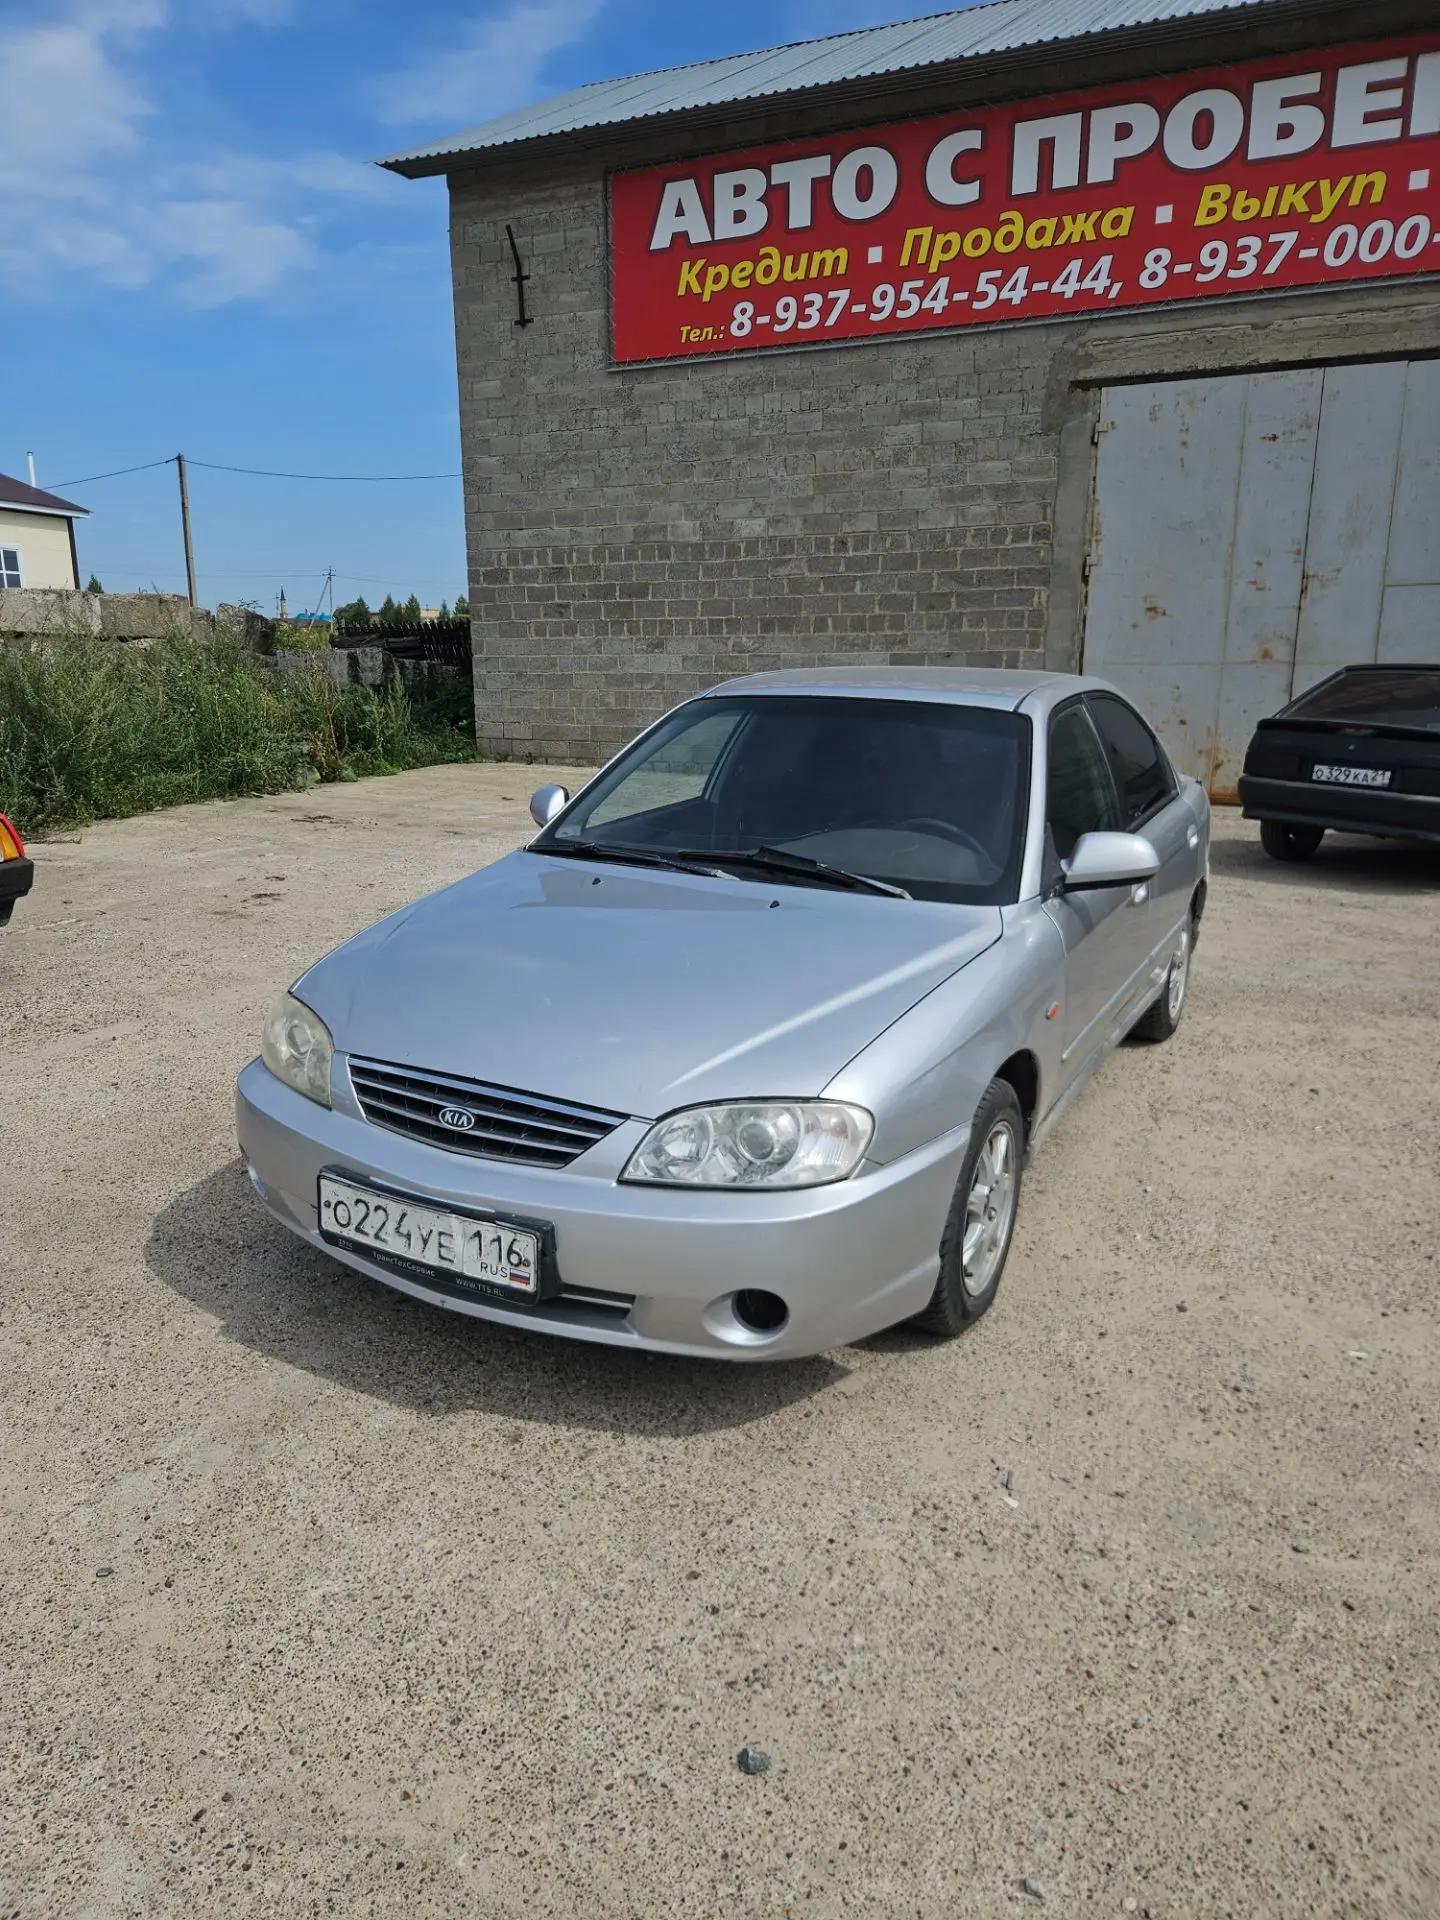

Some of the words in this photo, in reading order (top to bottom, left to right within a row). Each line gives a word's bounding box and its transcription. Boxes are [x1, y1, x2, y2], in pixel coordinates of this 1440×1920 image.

[649, 146, 899, 251] АВТО
[925, 129, 983, 206] С
[677, 246, 848, 303] Кредит
[899, 205, 1135, 274] Продажа
[1194, 169, 1387, 227] Выкуп
[679, 323, 725, 344] Тел.:
[729, 255, 1122, 338] 8-937-954-54-44,
[444, 1111, 468, 1127] KIA
[468, 1229, 524, 1268] 116
[480, 1261, 508, 1278] RUS
